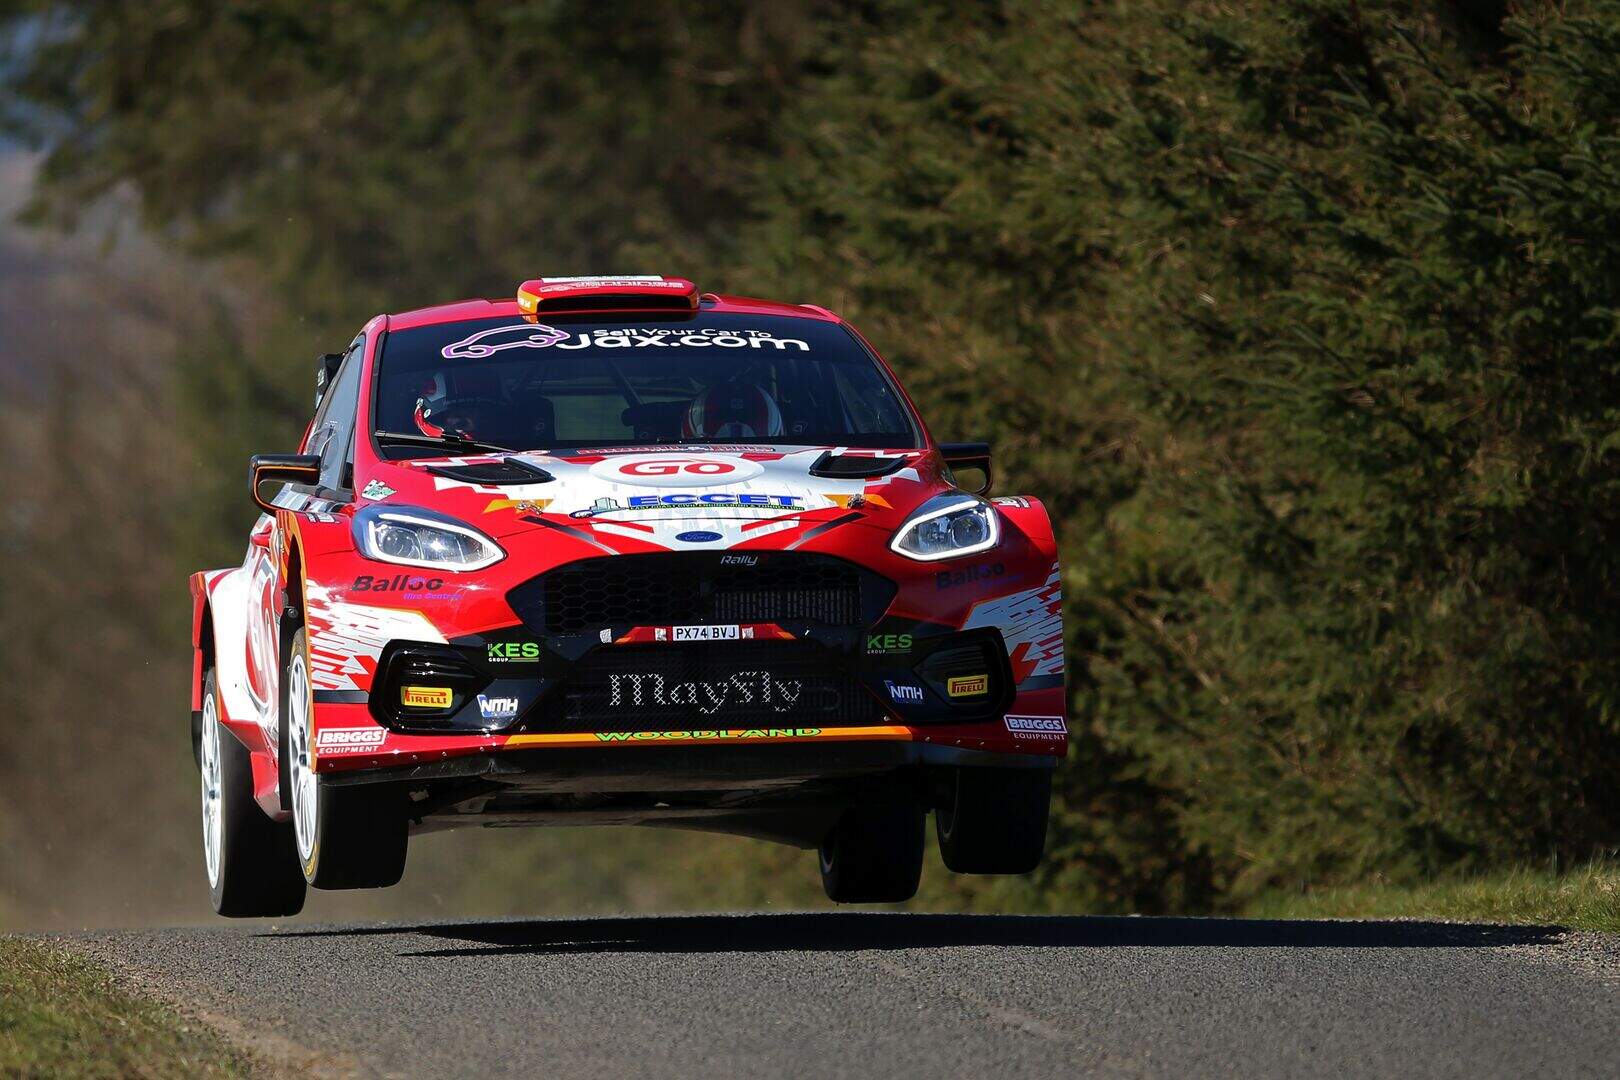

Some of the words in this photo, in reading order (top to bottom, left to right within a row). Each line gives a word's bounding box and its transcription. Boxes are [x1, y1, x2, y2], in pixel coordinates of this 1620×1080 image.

[593, 329, 638, 338] Sell
[641, 328, 697, 337] Your
[701, 328, 741, 337] Car
[744, 330, 772, 338] To
[555, 333, 810, 351] Jax.com
[618, 457, 736, 476] GO
[627, 493, 804, 508] ECCET
[720, 555, 760, 566] Rally
[351, 574, 444, 592] Balloo
[676, 627, 708, 640] PX74
[712, 626, 736, 639] BVJ
[867, 634, 913, 649] KES
[489, 642, 540, 657] KES
[404, 688, 448, 706] PIRELLI
[608, 671, 803, 715] Mayfly
[890, 685, 925, 700] NMH
[479, 696, 519, 712] NMH
[1009, 718, 1063, 731] BRIGGS
[320, 732, 384, 744] BRIGGS
[593, 727, 824, 741] WOODLAND
[1013, 732, 1066, 741] EQUIPMENT
[318, 745, 380, 754] EQUIPMENT
